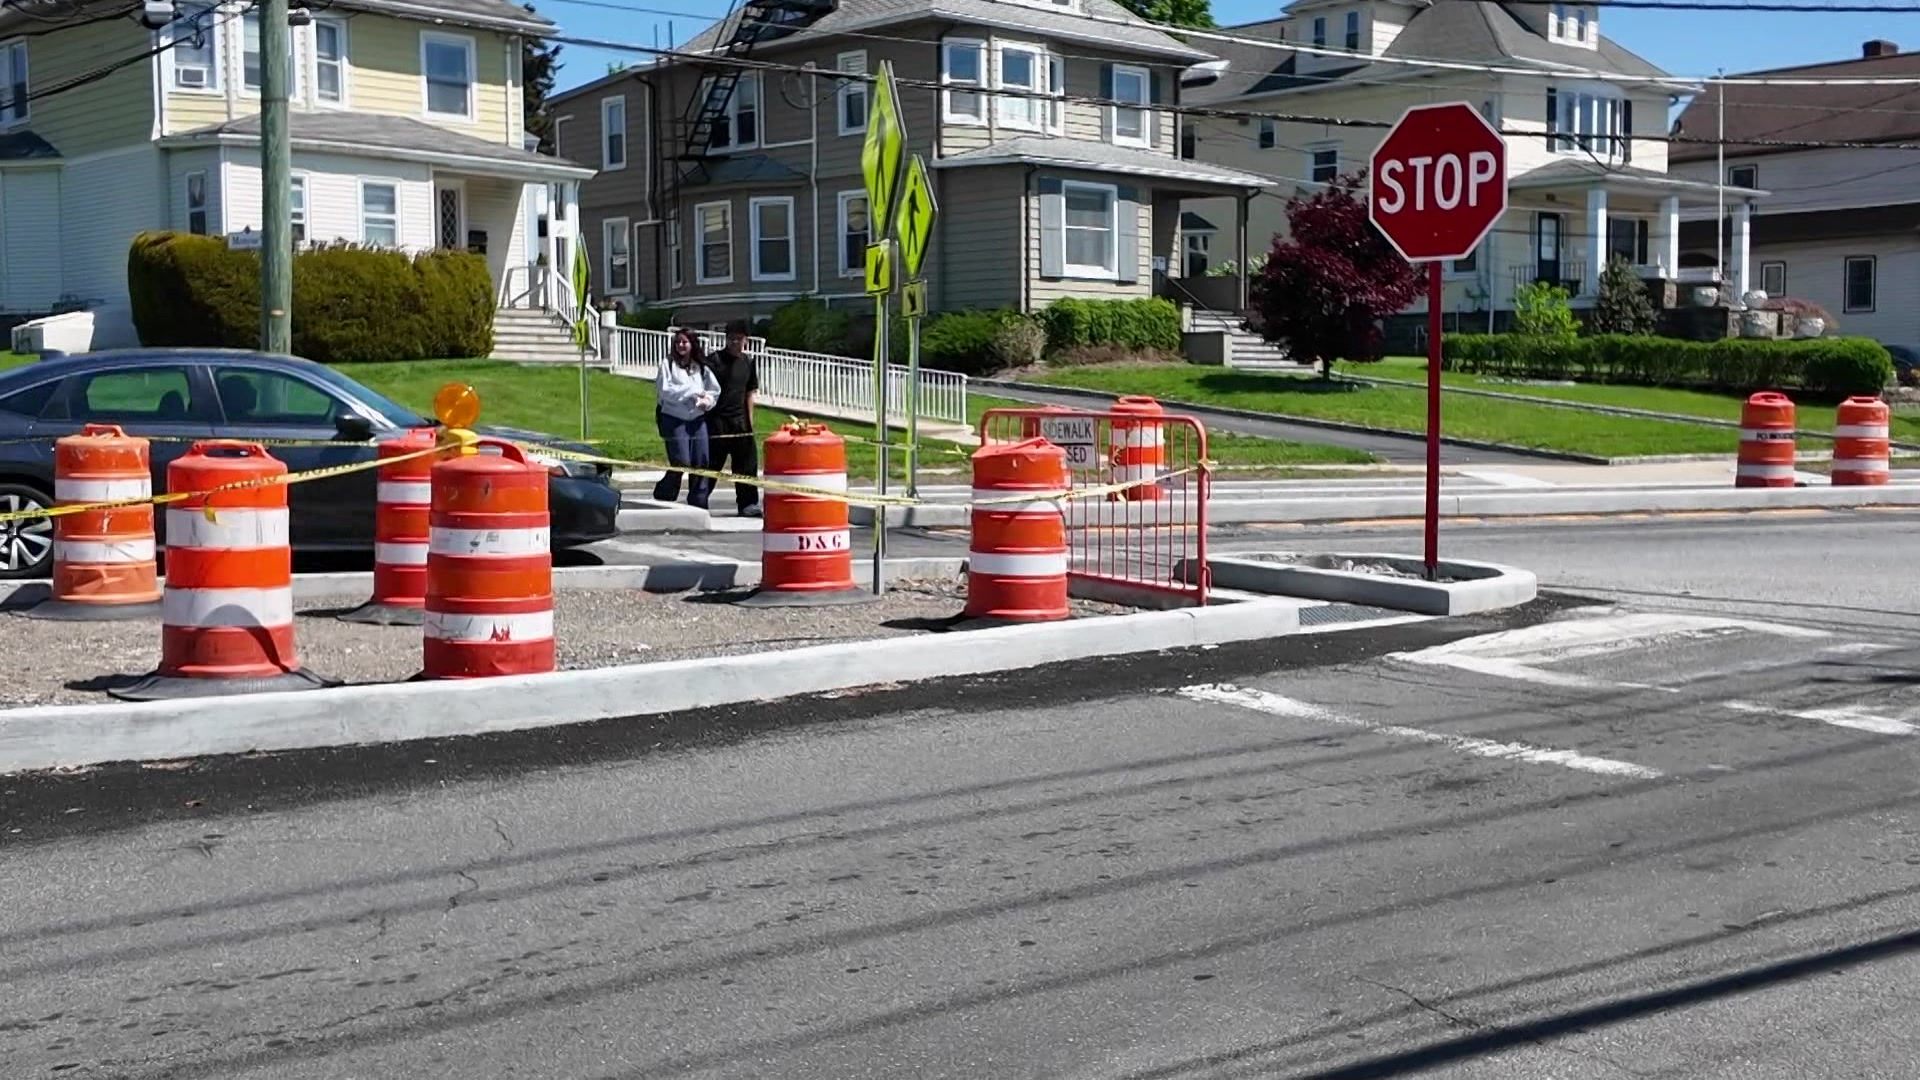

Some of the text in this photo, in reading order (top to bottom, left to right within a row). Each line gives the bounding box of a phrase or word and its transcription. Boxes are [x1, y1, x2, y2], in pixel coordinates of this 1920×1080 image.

[1379, 151, 1497, 214] STOP
[1043, 421, 1092, 439] SIDEWALK
[1067, 447, 1087, 463] SED
[798, 535, 811, 550] D
[815, 535, 827, 549] &
